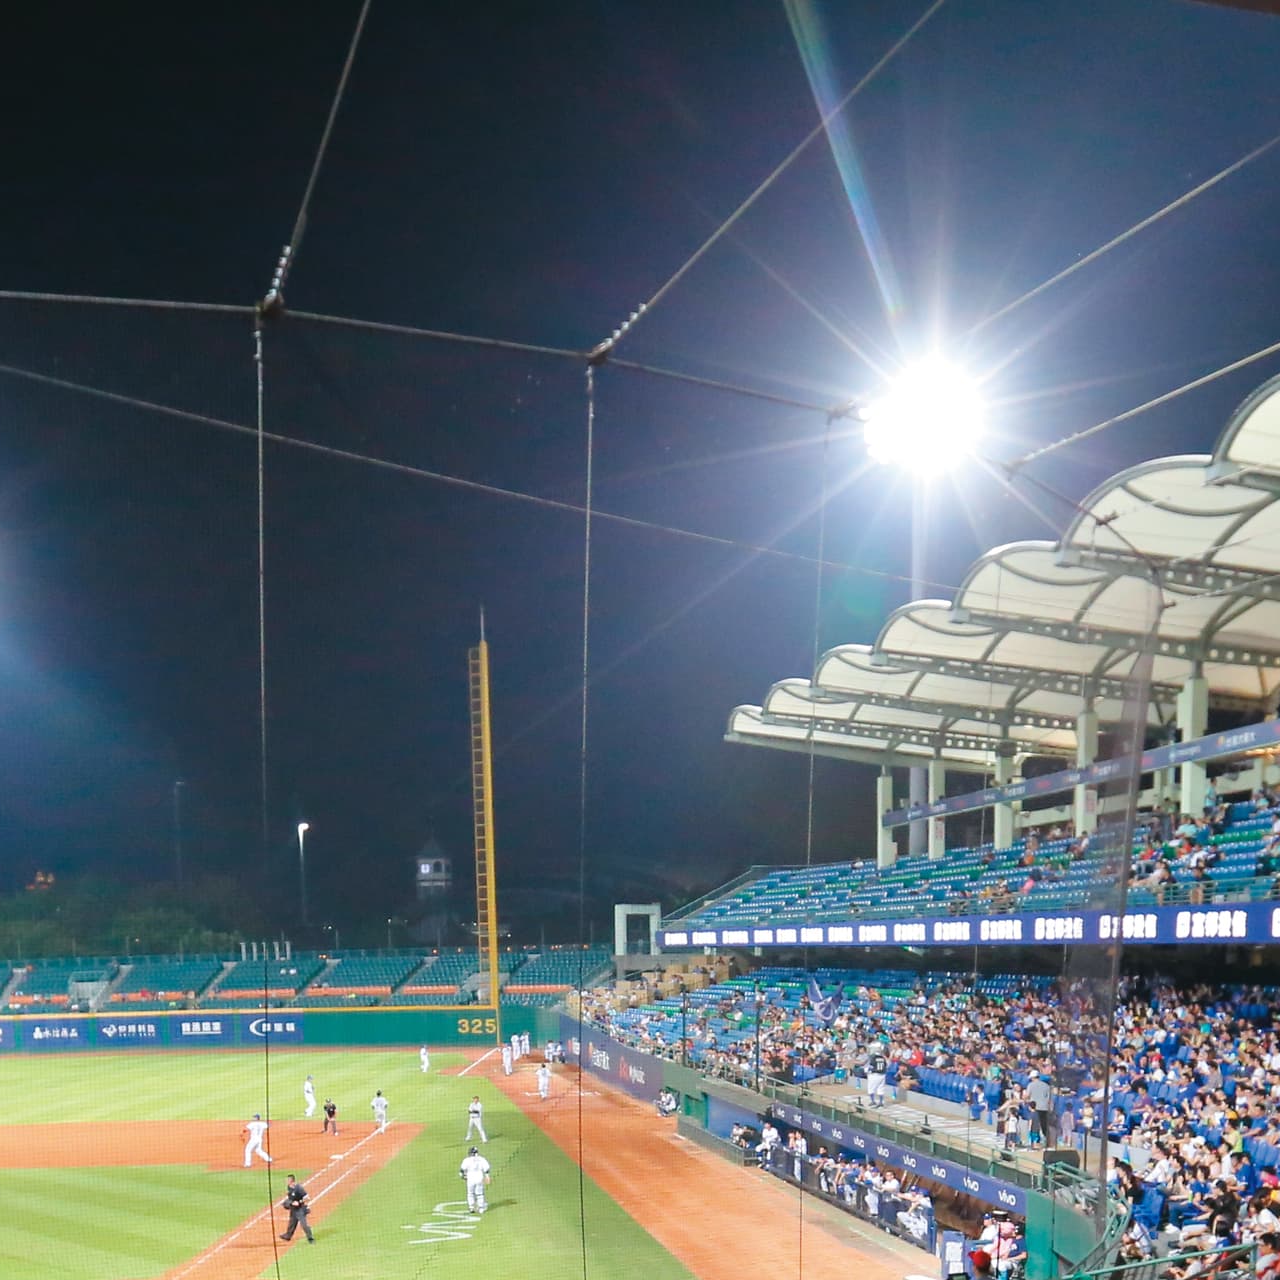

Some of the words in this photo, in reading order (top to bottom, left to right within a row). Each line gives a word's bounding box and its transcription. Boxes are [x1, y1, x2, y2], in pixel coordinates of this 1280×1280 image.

[457, 1018, 497, 1034] 325
[902, 1154, 917, 1168] vivo
[931, 1164, 947, 1179] vivo
[963, 1175, 980, 1192] vivo
[997, 1189, 1017, 1206] vivo
